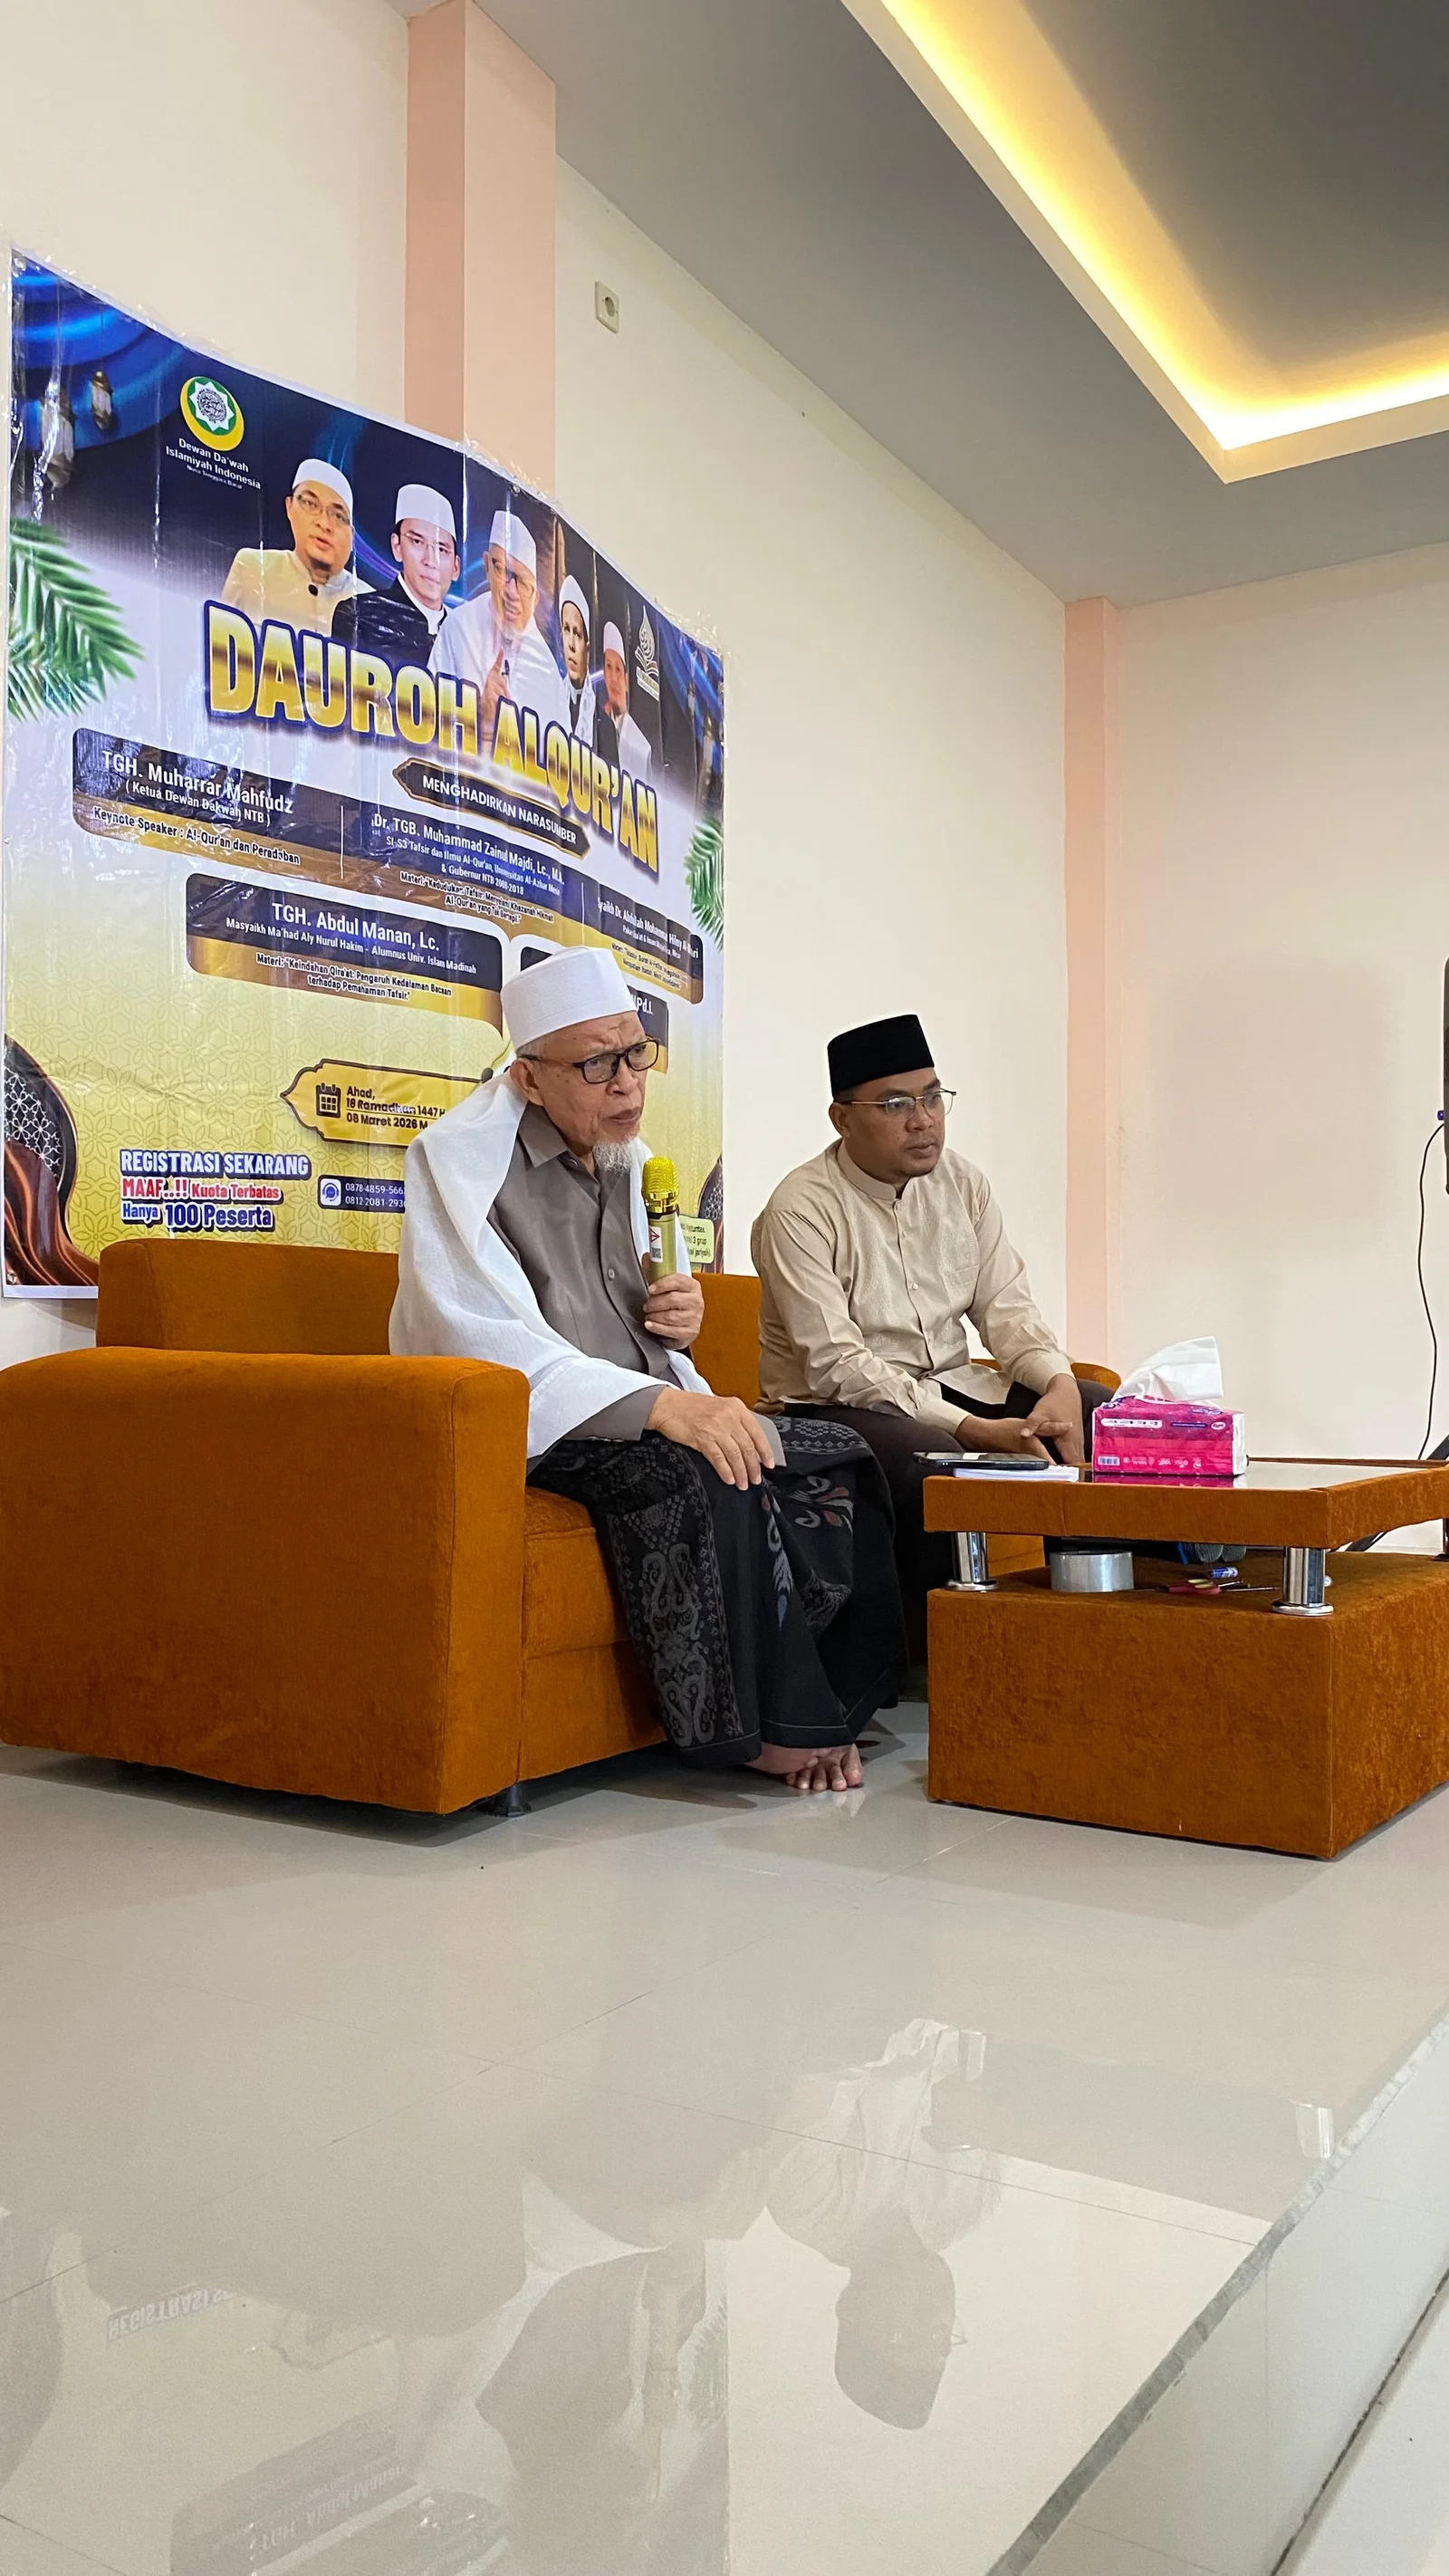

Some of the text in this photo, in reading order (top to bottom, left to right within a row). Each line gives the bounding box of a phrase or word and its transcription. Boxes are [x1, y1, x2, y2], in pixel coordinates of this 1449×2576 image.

[166, 446, 261, 489] Islamiyah Indonesia
[178, 437, 249, 472] Dewan Da'wah
[206, 603, 659, 875] DAUROH ALQUR'AN
[102, 750, 293, 814] TGH. Muharrar Mahfudz
[132, 782, 162, 799] Ketua
[165, 791, 199, 808] Dewan
[202, 798, 242, 818] Dakwah
[244, 809, 264, 823] NTB
[422, 774, 578, 844] MENGHADIRKAN NARASUMBER
[93, 806, 135, 827] Keynote
[138, 818, 178, 837] Speaker
[187, 830, 231, 849] Al-Qur'an
[233, 837, 250, 852] dan
[374, 813, 389, 830] Dr.
[392, 817, 420, 837] TGB.
[423, 824, 482, 853] Muhammad
[484, 841, 508, 861] Zainul
[509, 851, 535, 874] Majdi,
[537, 860, 551, 879] Lc.,
[409, 841, 430, 854] Tafsir
[431, 847, 443, 859] dan
[444, 850, 462, 862] Ilmu
[525, 876, 548, 890] Al-Azhar
[441, 863, 446, 872] &
[448, 865, 481, 880] Gubernur
[482, 872, 495, 885] NTB
[272, 902, 440, 952] TGH. Abdul Manan, Lc.
[476, 903, 492, 916] yang
[226, 918, 266, 936] Masyaikh
[301, 929, 314, 945] Aly
[316, 934, 339, 948] Nurul
[340, 937, 364, 953] Hakim
[372, 946, 407, 961] Alumnus
[408, 950, 426, 965] Univ.
[427, 955, 446, 968] Islam
[446, 959, 476, 975] Madinah
[255, 952, 284, 968] Materi:
[356, 970, 391, 987] Pengaruh
[391, 975, 429, 992] Kedalaman
[430, 983, 452, 996] Bacaan
[308, 975, 341, 993] terhadap
[342, 981, 387, 998] Pemahaman
[346, 1085, 376, 1100] Ahad,
[346, 1097, 356, 1109] 18
[357, 1100, 417, 1115] Ramadhan
[417, 1105, 437, 1118] 1447
[346, 1112, 428, 1129] 08 Maret 2026 M
[121, 1150, 309, 1176] REGISTRASI SEKARANG
[191, 1182, 227, 1198] Kuota
[230, 1184, 280, 1199] Terbatas
[345, 1183, 404, 1196] 0878-4859-566
[122, 1203, 272, 1226] Hanya 100 Peserta
